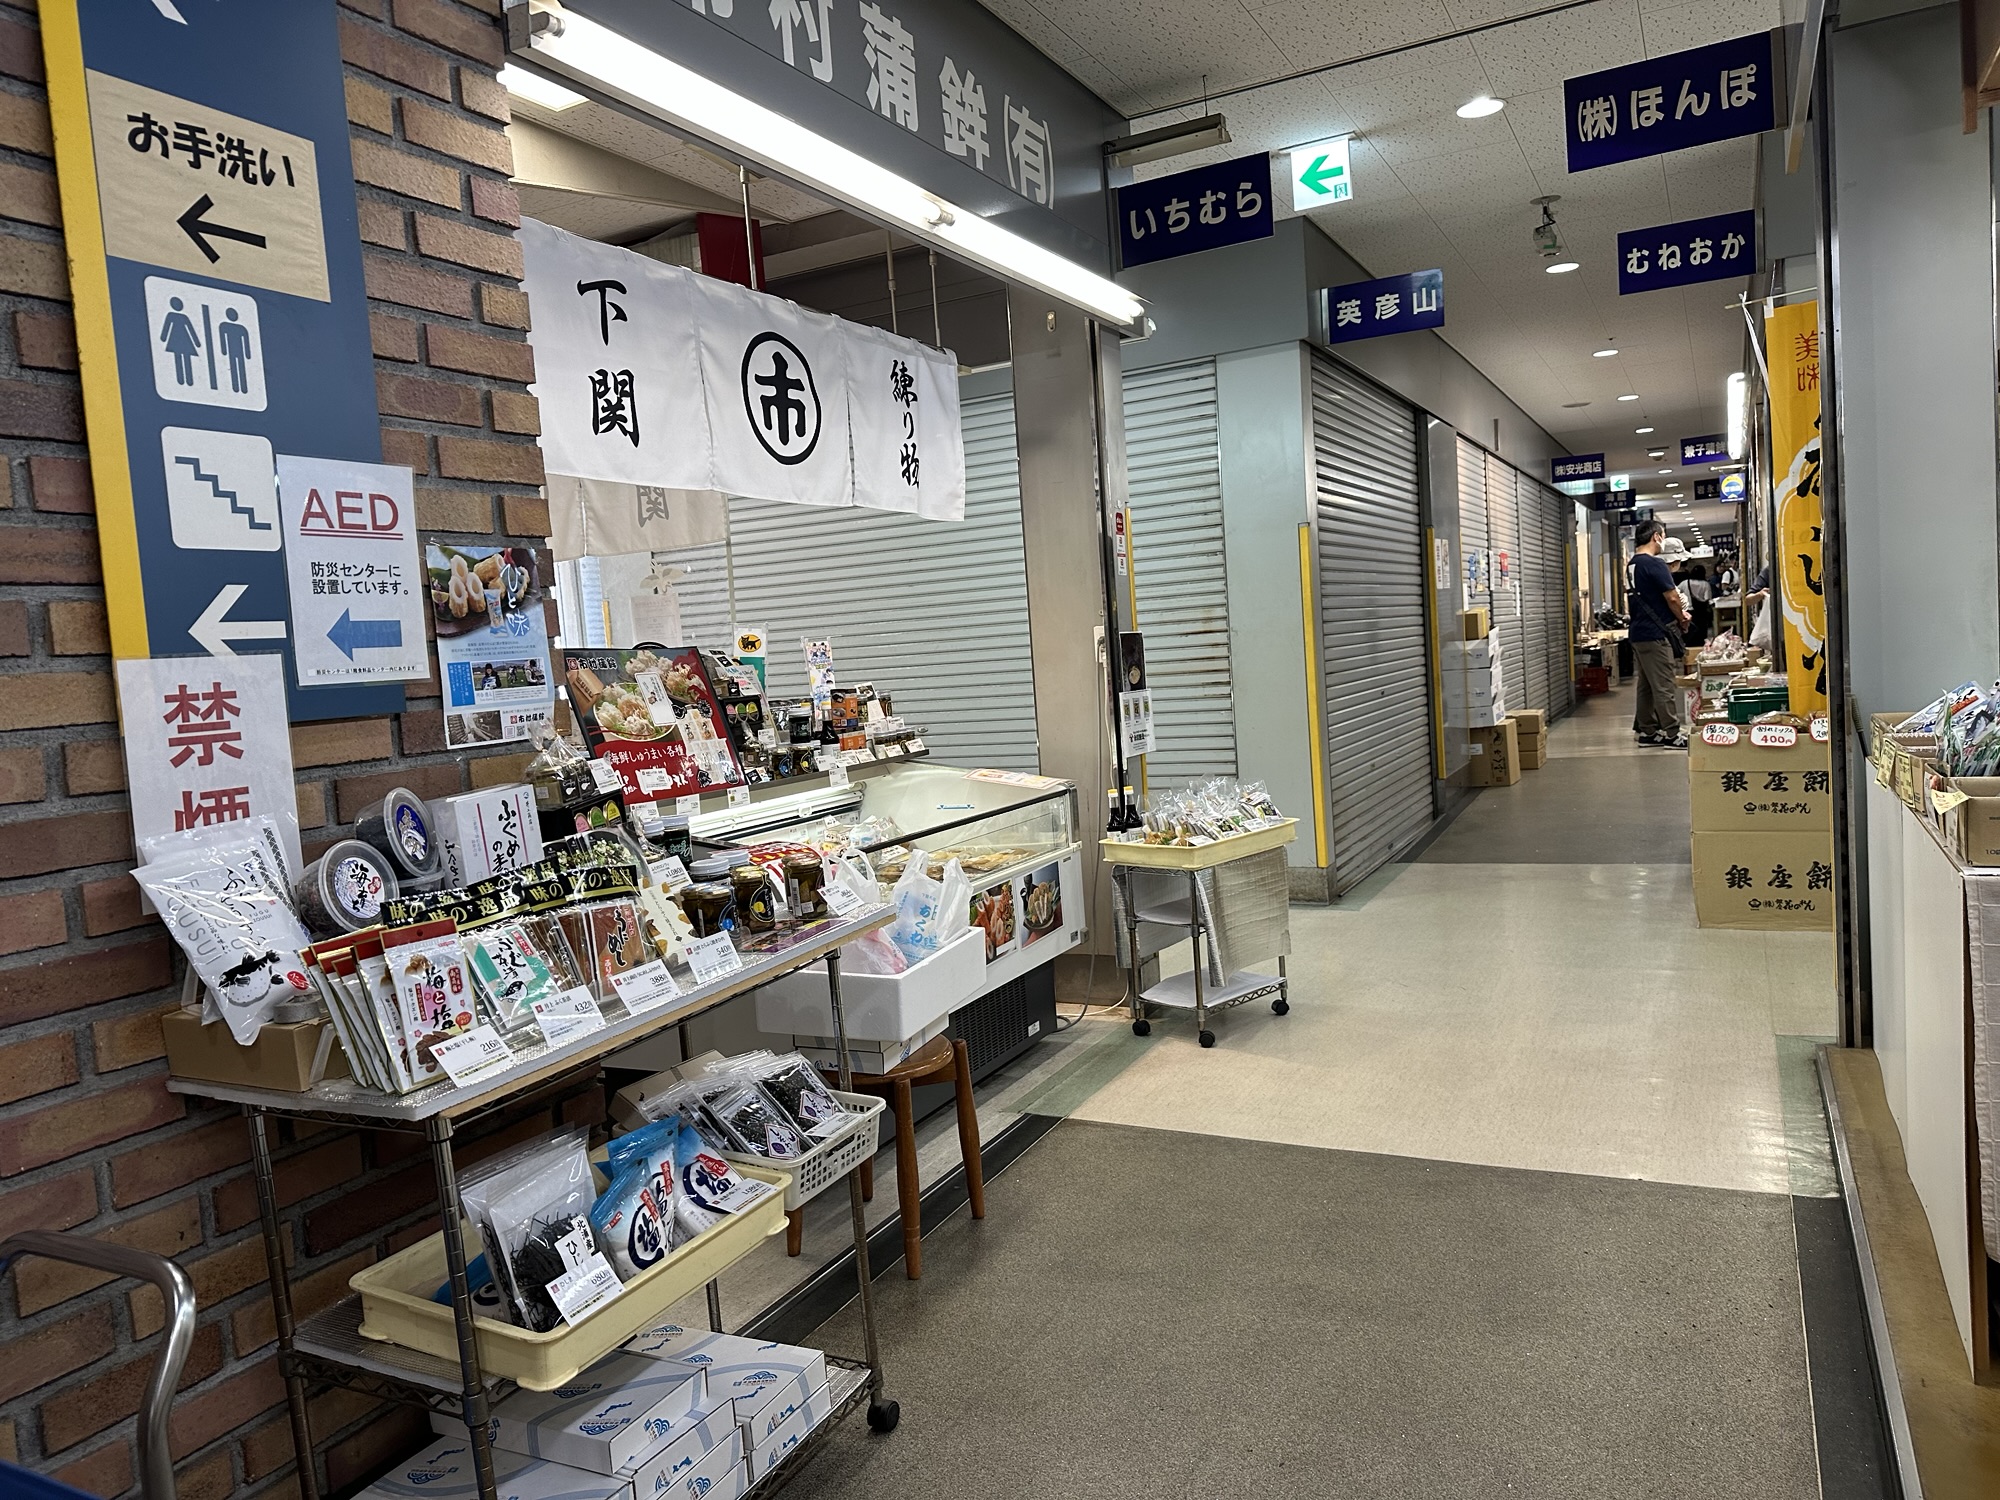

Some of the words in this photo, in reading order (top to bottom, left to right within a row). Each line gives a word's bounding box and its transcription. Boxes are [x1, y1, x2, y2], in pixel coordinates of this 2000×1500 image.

[690, 0, 1055, 210] 村蒲鉾(有)
[127, 111, 296, 188] お手洗い
[1130, 182, 1263, 239] いちむら
[1626, 232, 1746, 275] むねおか
[1336, 287, 1437, 328] 英彦山
[577, 280, 640, 447] 下関
[890, 359, 920, 489] 練り物
[300, 488, 399, 531] AED
[311, 561, 401, 577] 防災センターに
[312, 579, 409, 595] 設置しています。
[500, 563, 530, 637] ひと味
[1761, 735, 1793, 744] 400円
[1721, 771, 1830, 794] 銀座餅
[1725, 861, 1832, 892] 銀座餅
[650, 973, 669, 985] 388円
[574, 1001, 594, 1012] 432円
[480, 1039, 501, 1052] 216円
[590, 1270, 611, 1285] 680円
